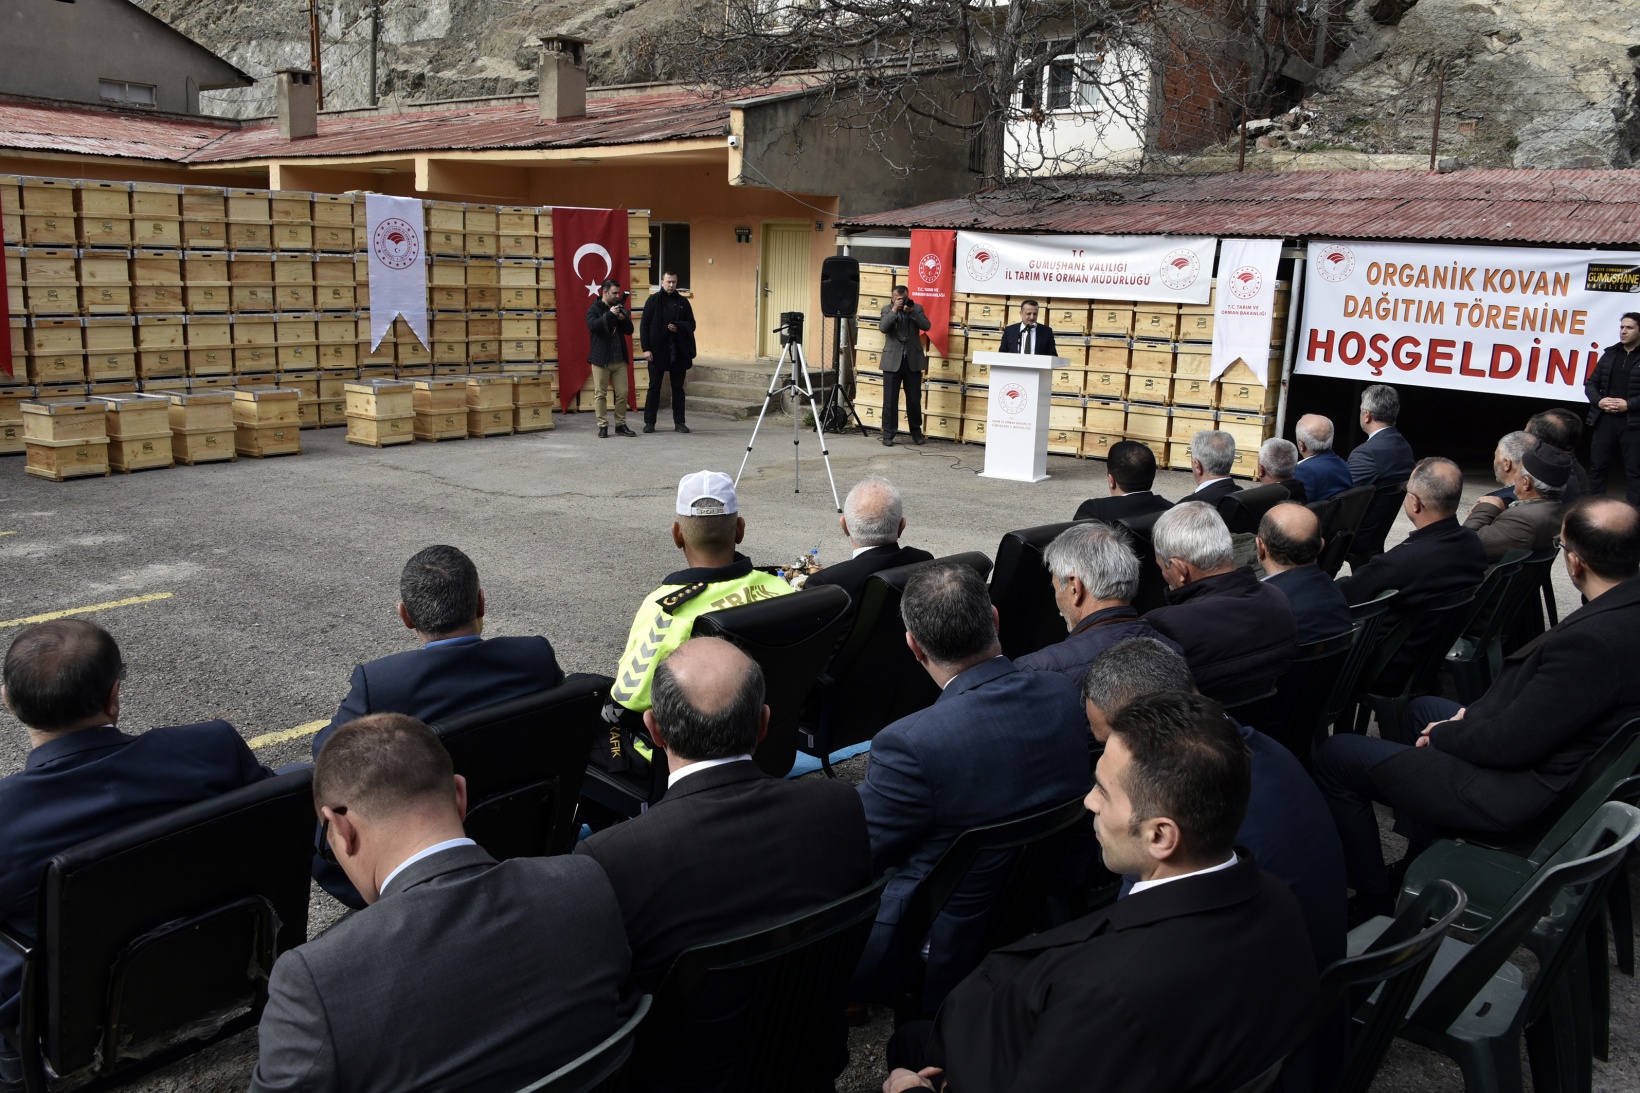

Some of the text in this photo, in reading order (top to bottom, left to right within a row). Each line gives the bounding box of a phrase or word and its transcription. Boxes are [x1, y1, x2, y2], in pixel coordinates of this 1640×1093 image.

[1005, 268, 1151, 286] İL TARIM VE ORMAN MÜDÜRLÜĞÜ
[1366, 261, 1477, 291] ORGANİK
[1482, 268, 1571, 297] KOVAN
[1343, 291, 1588, 335] DAĞITIM TÖRENİNE
[1306, 328, 1599, 386] HOŞGELDİNİ
